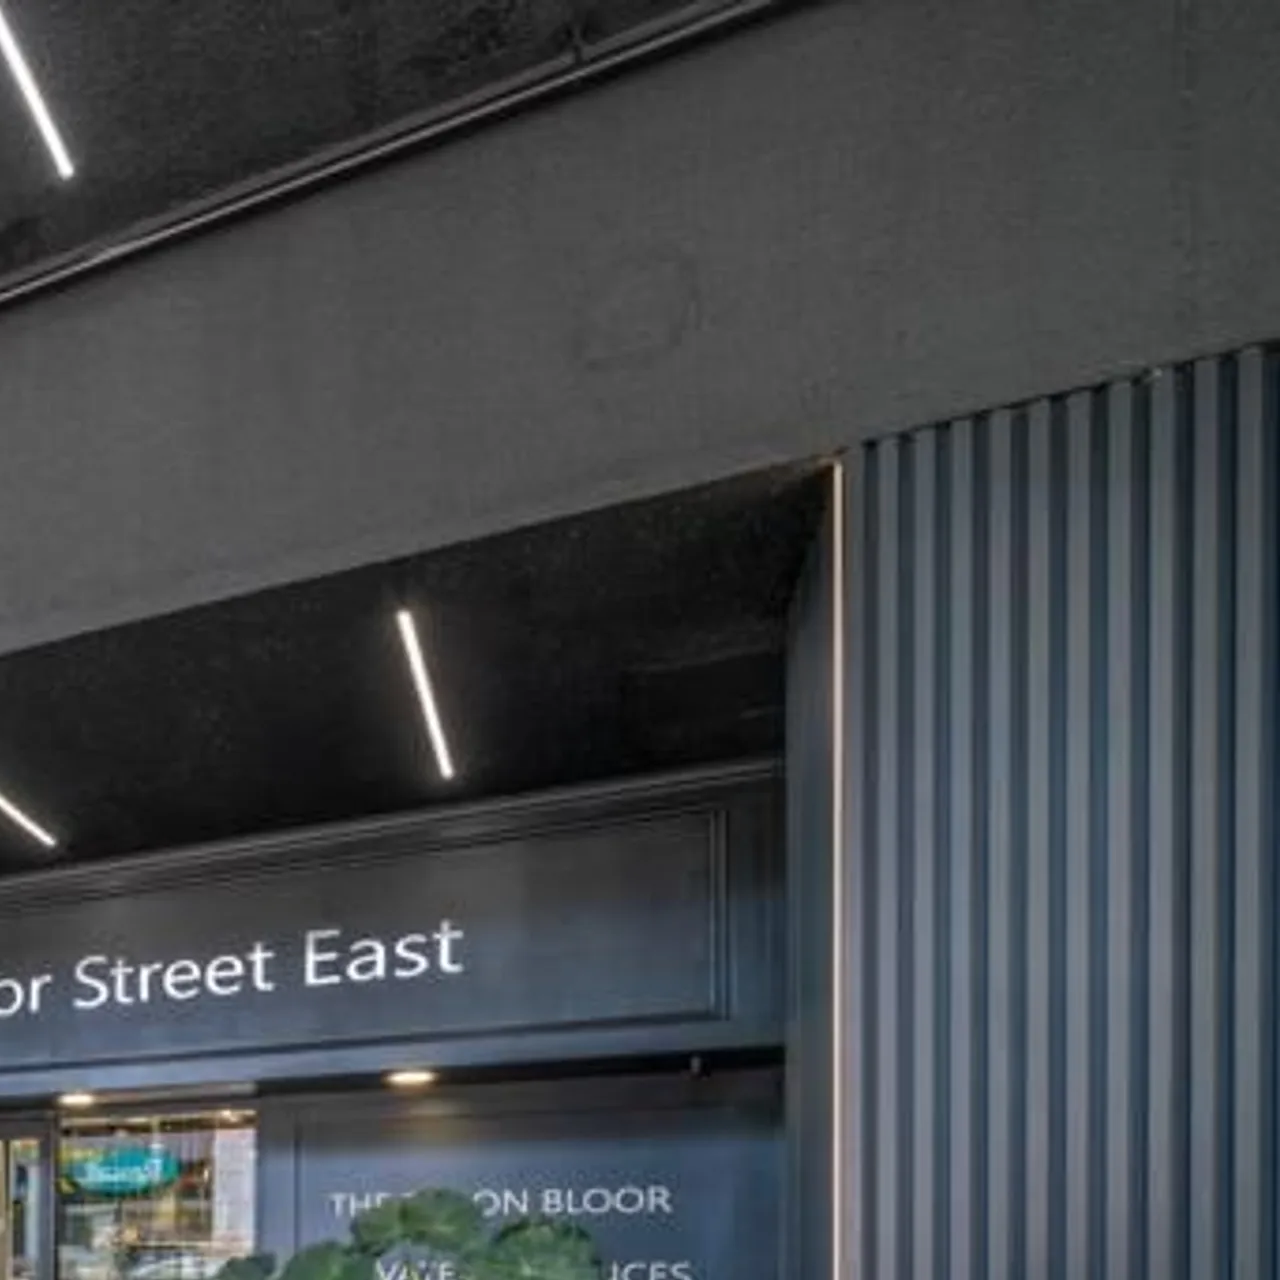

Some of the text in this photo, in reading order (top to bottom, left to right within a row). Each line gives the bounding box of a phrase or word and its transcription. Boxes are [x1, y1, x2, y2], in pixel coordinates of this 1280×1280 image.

[72, 941, 276, 1009] Street
[304, 918, 465, 988] East
[542, 1185, 674, 1214] BLOOR
